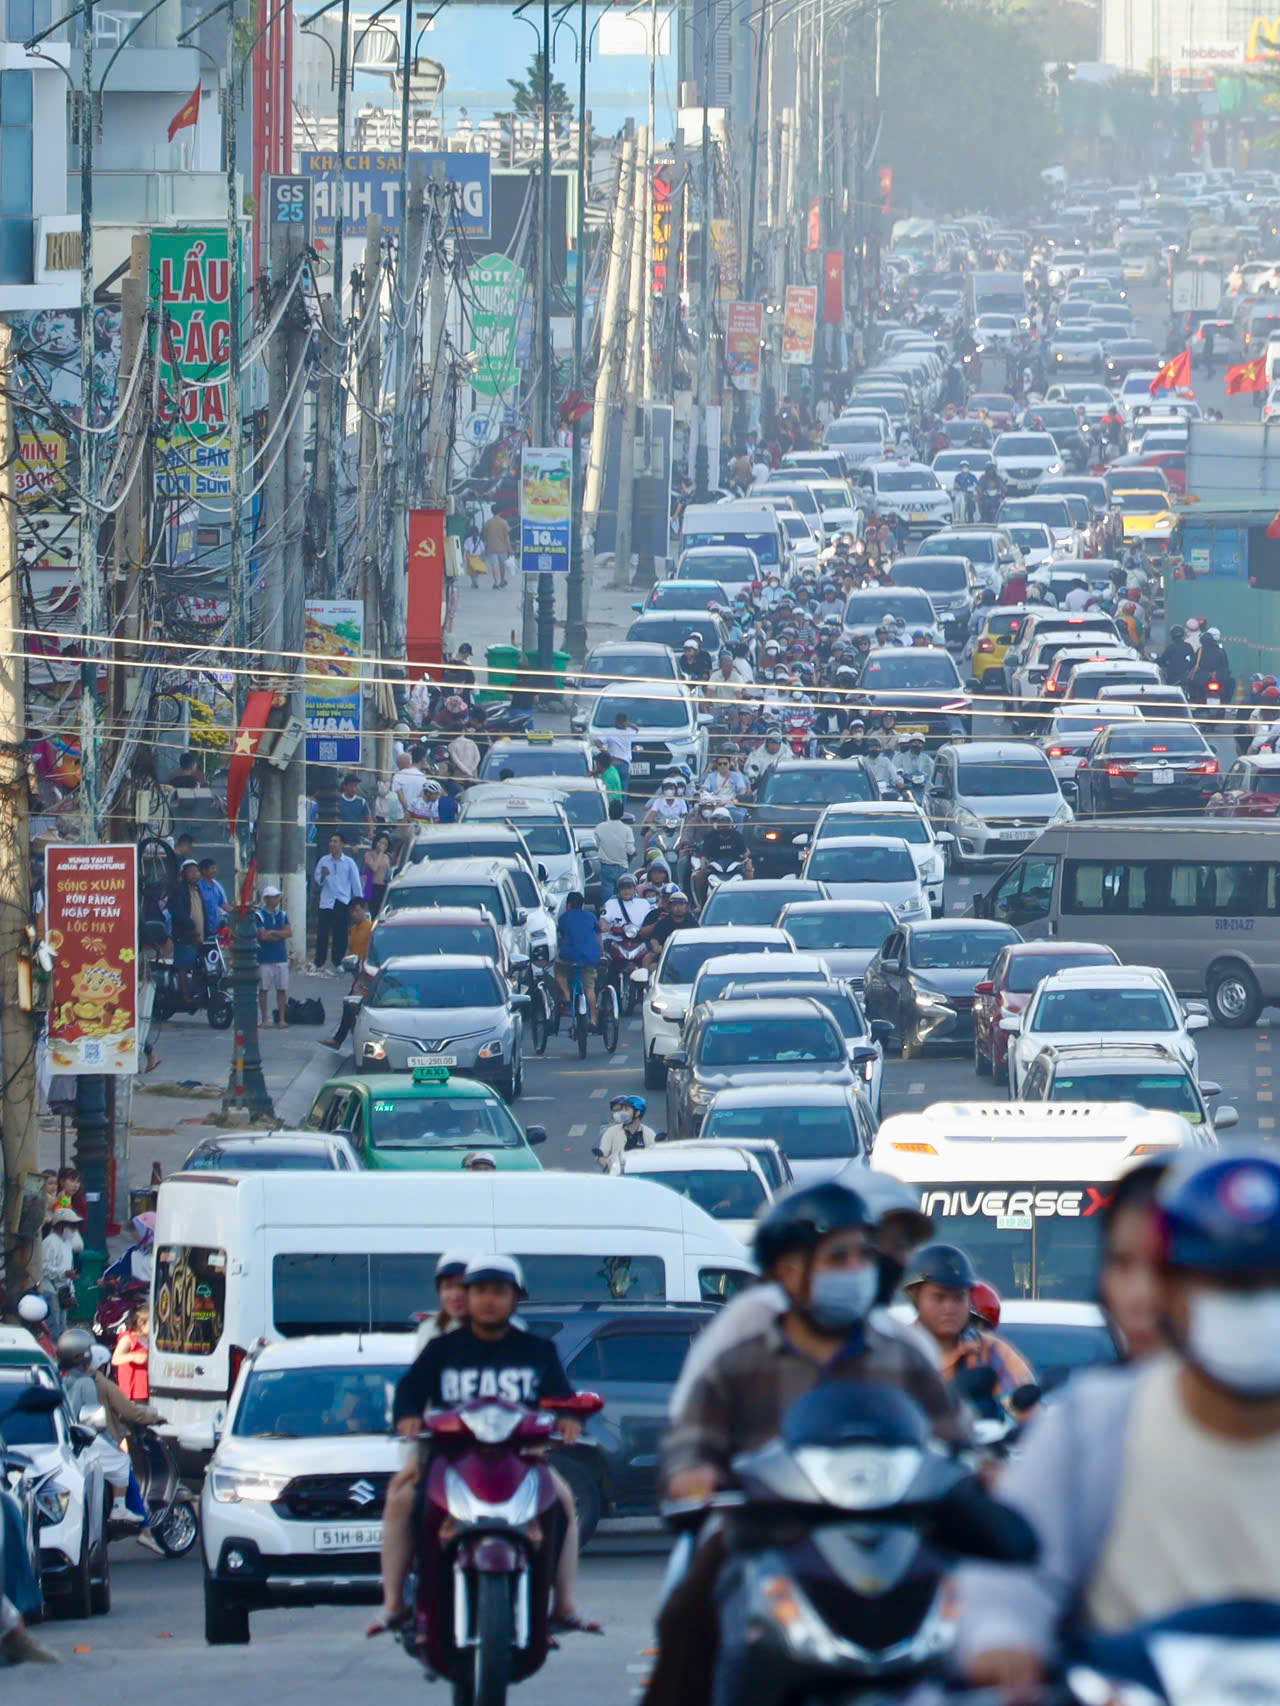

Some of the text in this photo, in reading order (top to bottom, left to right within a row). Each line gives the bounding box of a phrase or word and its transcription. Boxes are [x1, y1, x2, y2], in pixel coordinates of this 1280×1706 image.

[277, 185, 304, 202] GS
[277, 203, 304, 221] 25
[160, 240, 230, 303] LẨU
[160, 309, 231, 365] CÁC
[441, 1367, 535, 1402] BEAST
